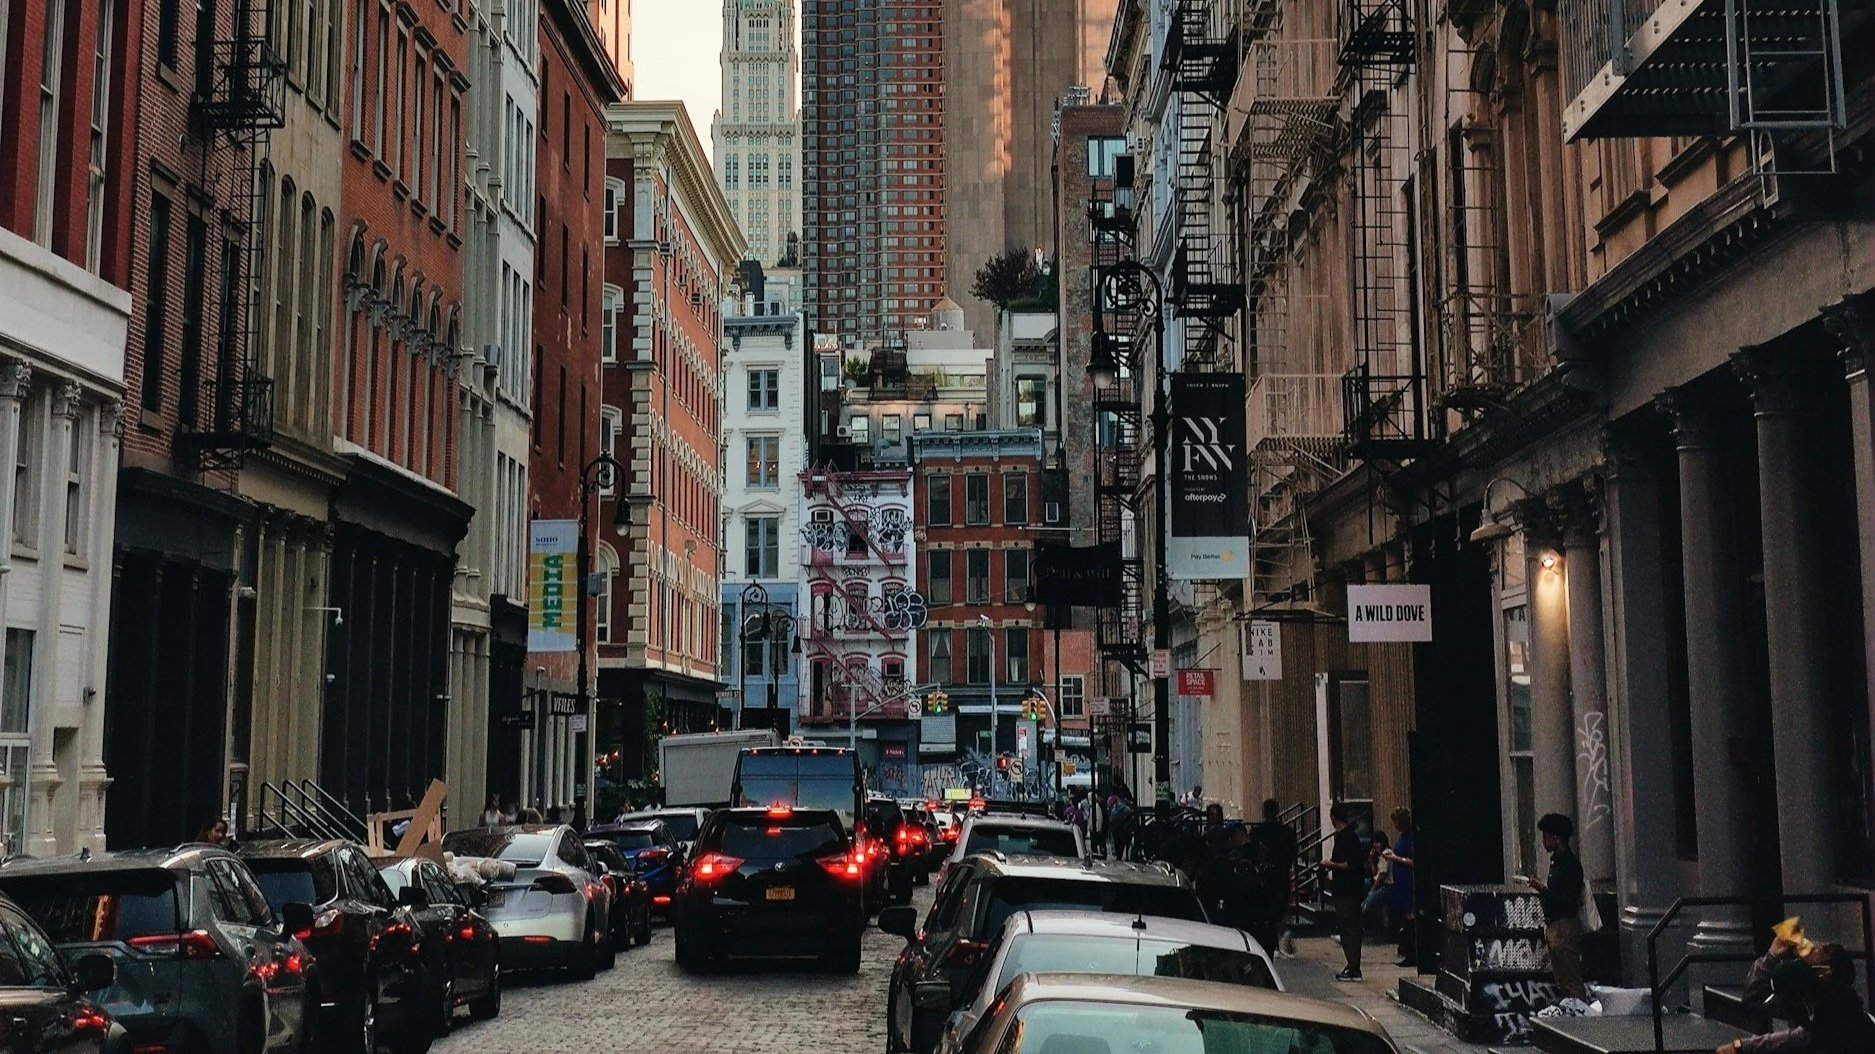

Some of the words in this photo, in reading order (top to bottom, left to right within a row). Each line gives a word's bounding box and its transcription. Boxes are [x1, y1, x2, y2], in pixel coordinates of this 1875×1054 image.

[1182, 417, 1227, 444] NY
[1182, 444, 1236, 471] FW
[1184, 493, 1218, 502] afterpay
[1190, 553, 1202, 561] Pay
[543, 555, 563, 628] MEDIA
[1356, 605, 1362, 621] A
[1365, 605, 1393, 621] WILD
[1396, 605, 1425, 621] DOVE
[554, 697, 576, 713] VFILES
